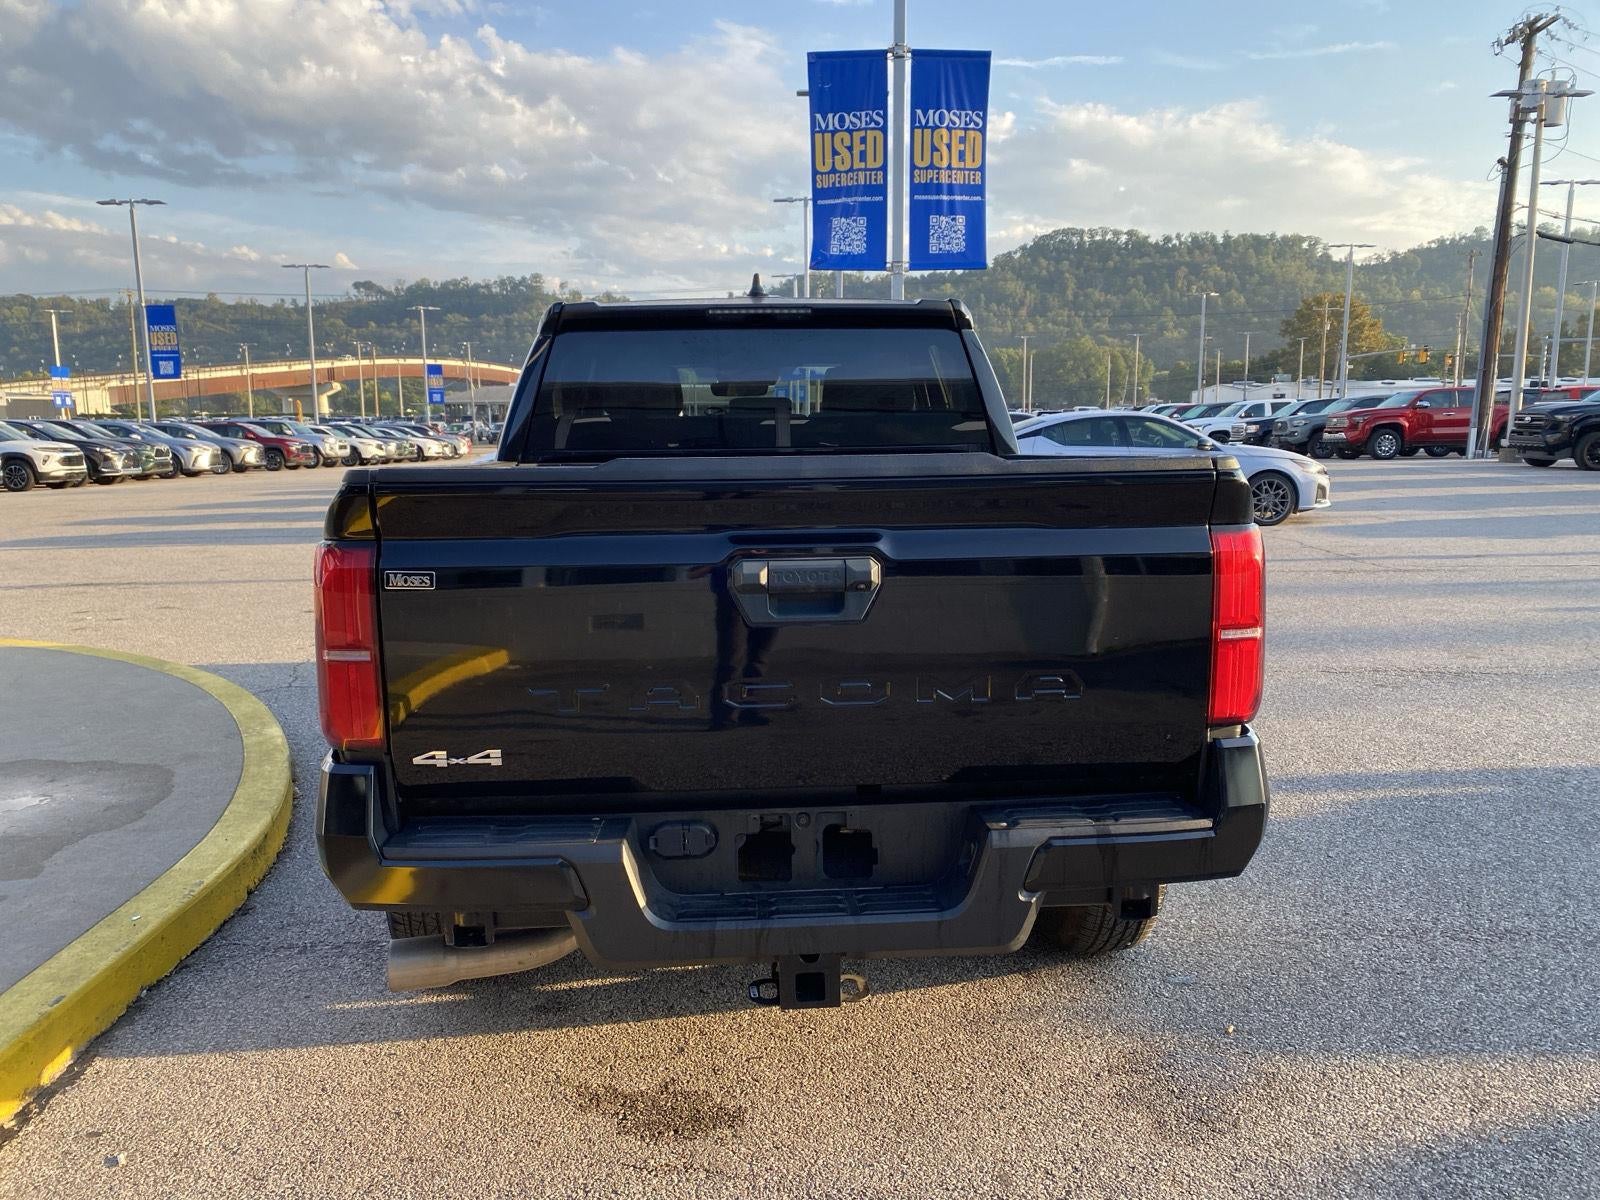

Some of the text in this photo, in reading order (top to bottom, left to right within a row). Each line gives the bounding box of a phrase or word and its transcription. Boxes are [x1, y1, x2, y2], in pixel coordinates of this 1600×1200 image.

[814, 110, 884, 131] MOSES
[914, 109, 983, 129] MOSES
[814, 130, 884, 172] USED
[914, 128, 983, 169] USED
[816, 171, 883, 188] SUPERCENTER
[914, 170, 982, 185] SUPERCENTER
[151, 332, 177, 345] USED
[388, 573, 431, 587] MOSES
[772, 569, 841, 584] TOYOTA
[528, 668, 1084, 713] TACOMA
